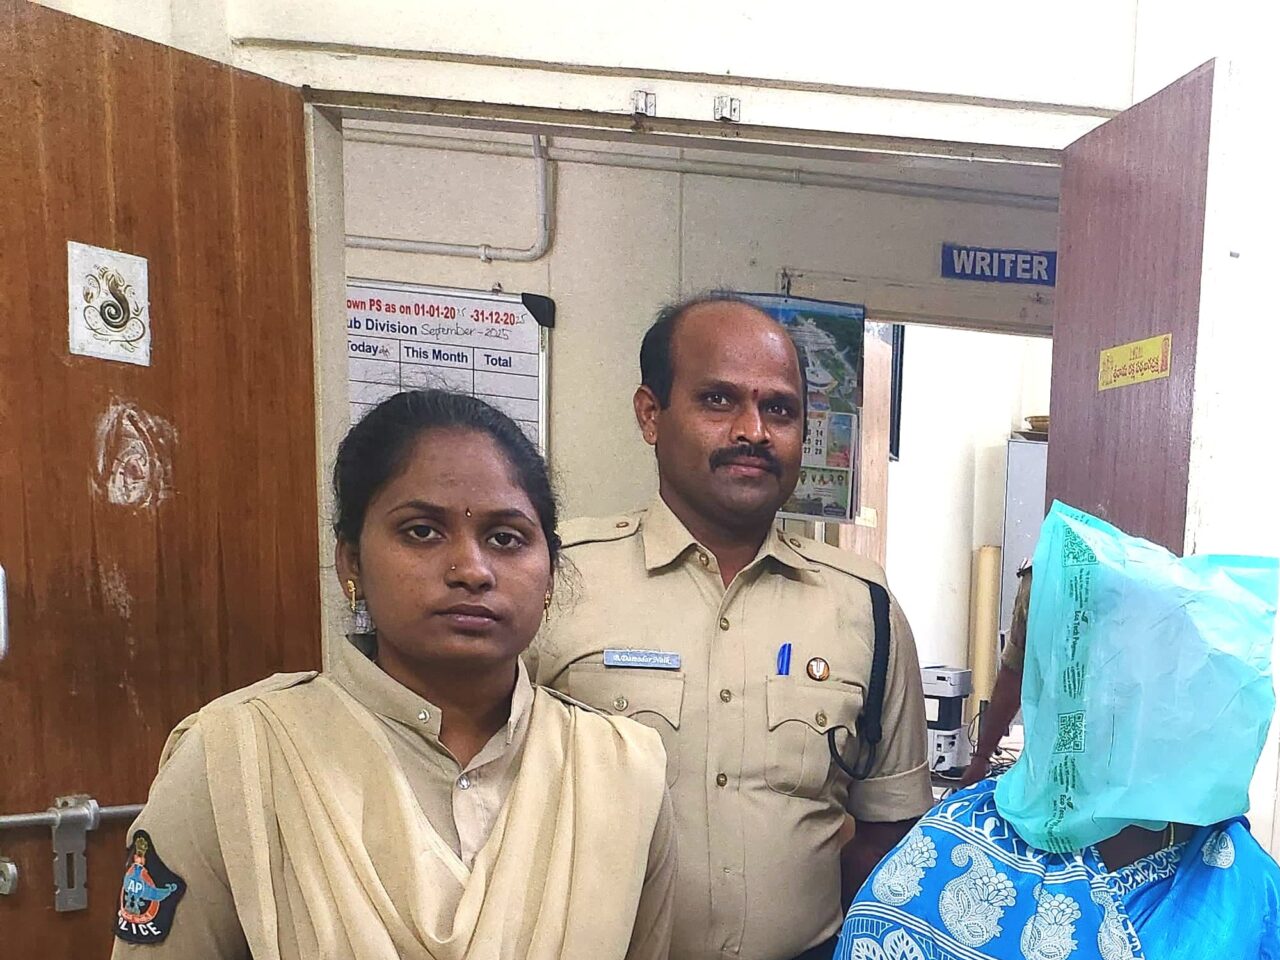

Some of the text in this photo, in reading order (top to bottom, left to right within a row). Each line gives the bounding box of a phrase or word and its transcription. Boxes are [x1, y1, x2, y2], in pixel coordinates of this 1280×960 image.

[953, 249, 1048, 280] WRITER
[369, 298, 382, 312] PS
[385, 303, 397, 313] as
[399, 305, 412, 315] on
[365, 318, 418, 336] Division
[404, 345, 429, 360] This
[432, 348, 469, 364] Month
[484, 354, 513, 368] Total
[128, 880, 143, 894] AP
